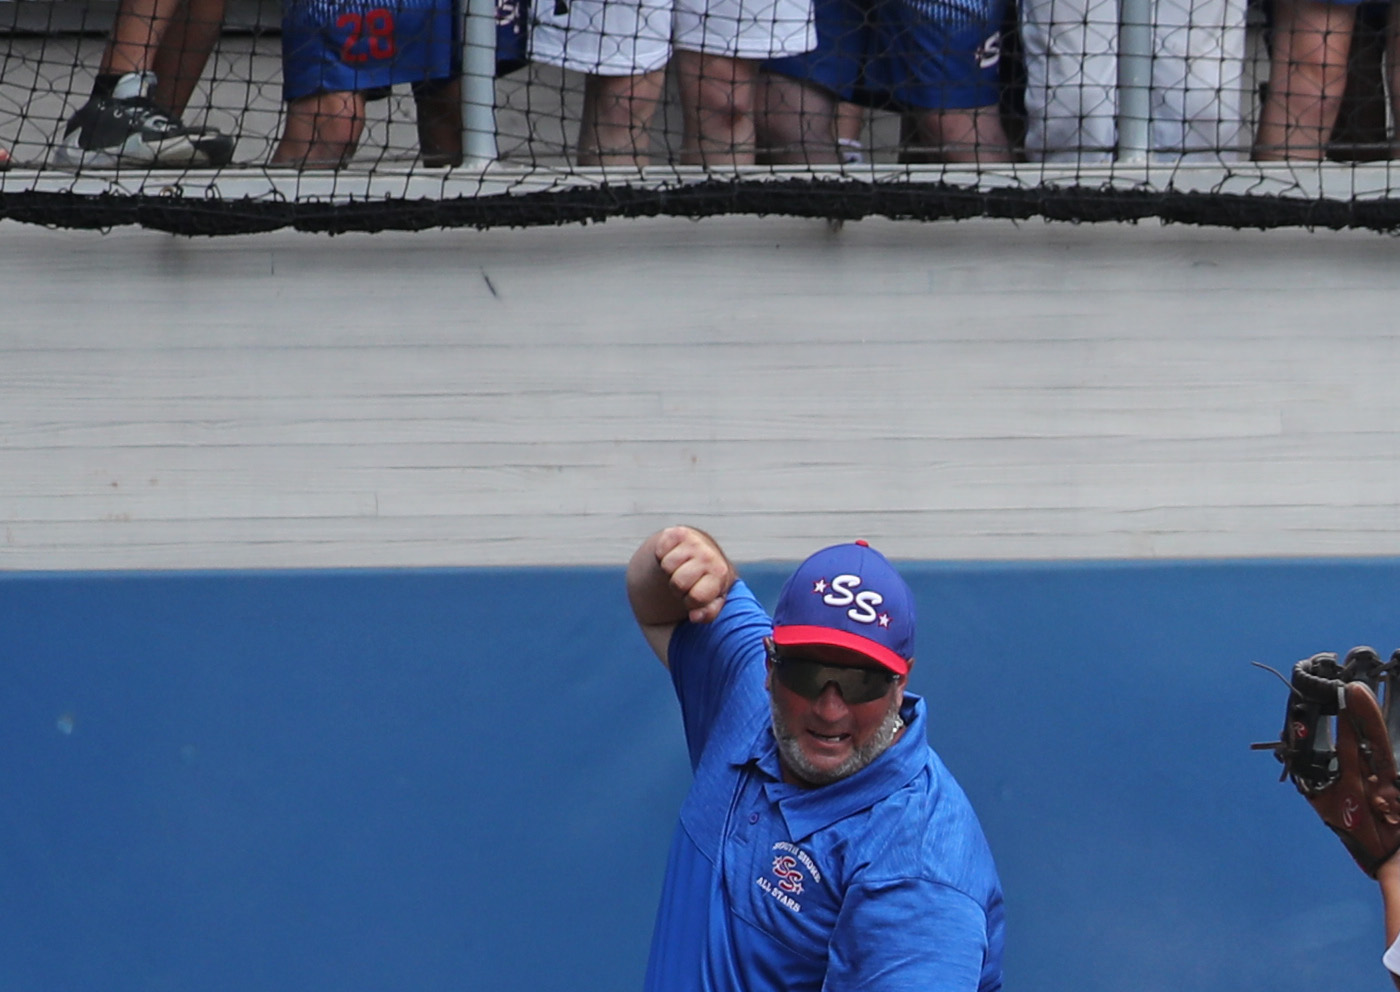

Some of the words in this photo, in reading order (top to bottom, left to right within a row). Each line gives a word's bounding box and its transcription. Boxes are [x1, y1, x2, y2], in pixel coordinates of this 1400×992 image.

[336, 8, 395, 62] 28
[823, 574, 883, 624] SS
[756, 876, 772, 893] ALL
[771, 887, 801, 913] STARS
